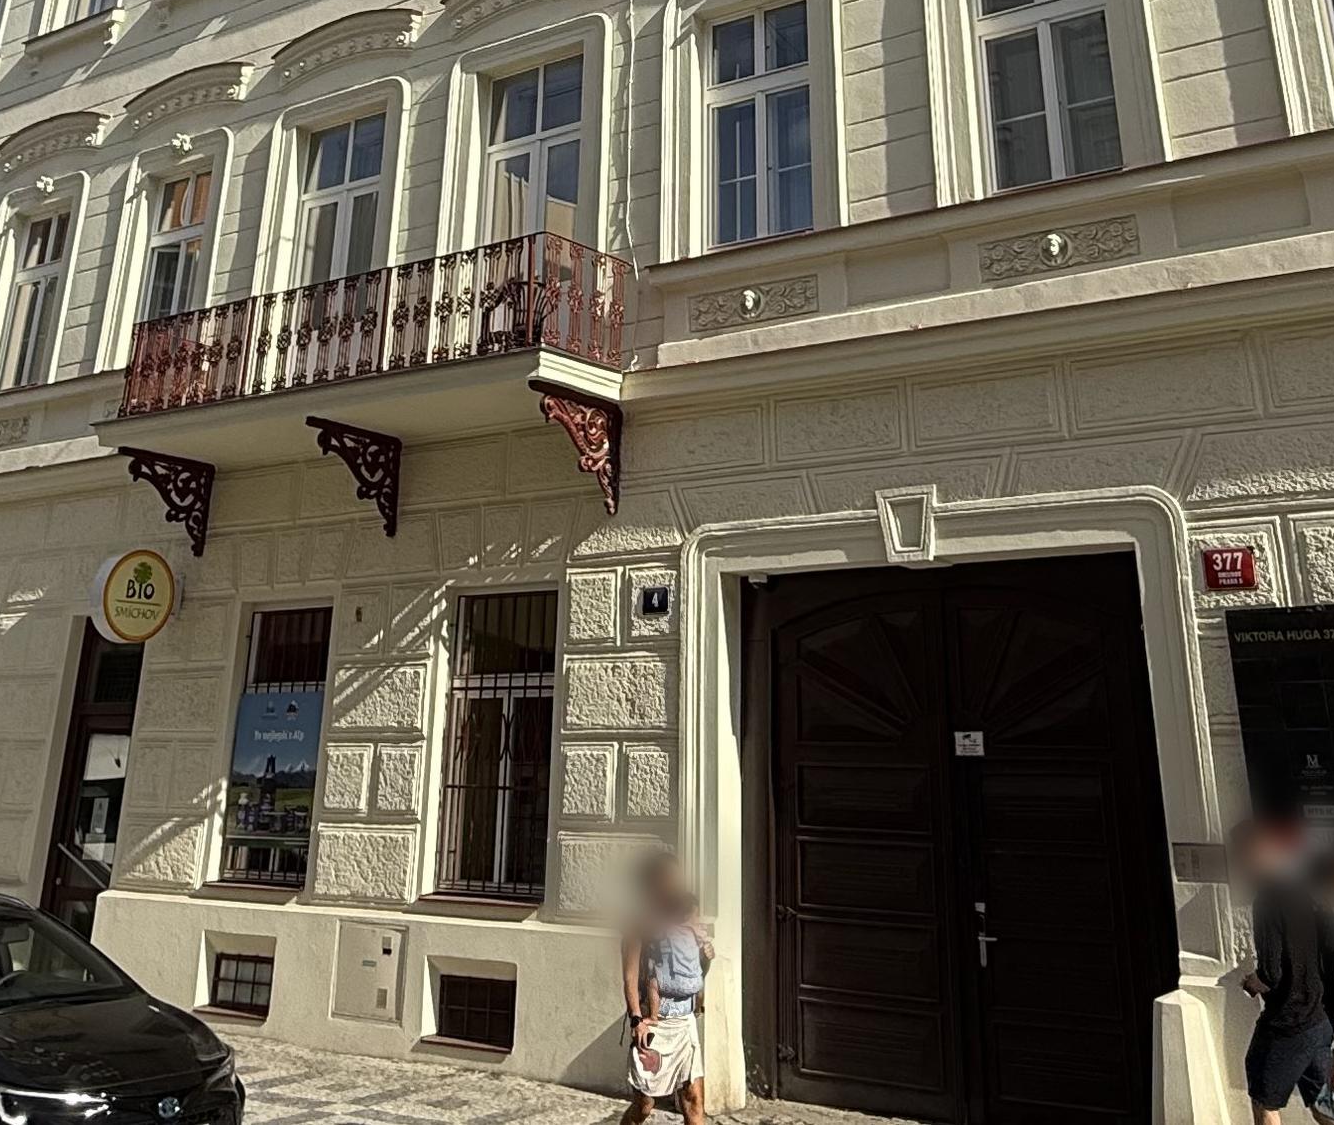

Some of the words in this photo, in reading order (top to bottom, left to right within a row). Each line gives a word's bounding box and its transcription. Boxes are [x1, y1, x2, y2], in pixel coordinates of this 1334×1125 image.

[1212, 552, 1243, 571] 377
[125, 579, 155, 600] BIO
[652, 592, 659, 607] 4
[1234, 630, 1285, 643] VIKTORA
[1286, 629, 1321, 642] HUGA
